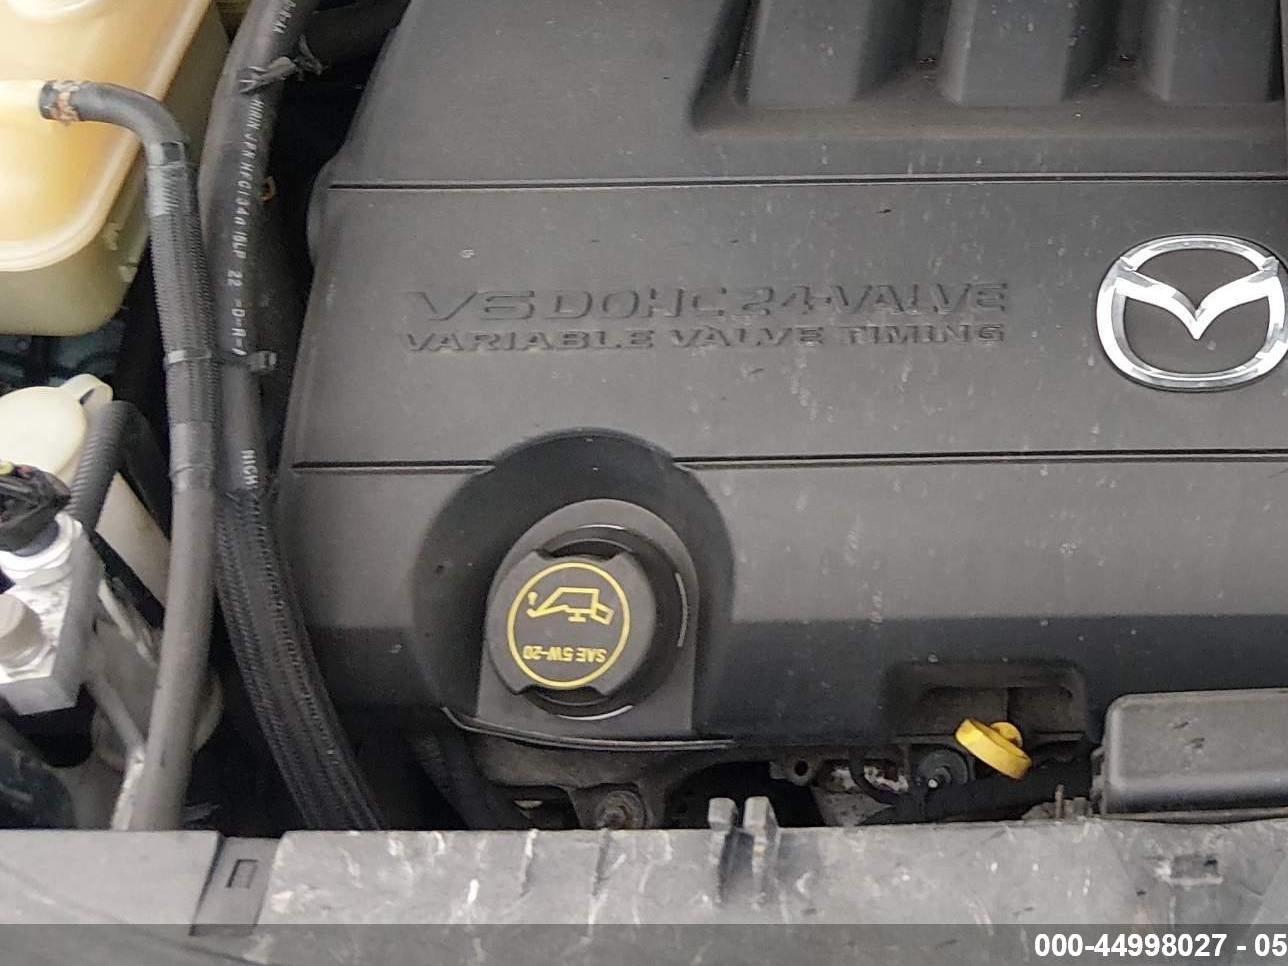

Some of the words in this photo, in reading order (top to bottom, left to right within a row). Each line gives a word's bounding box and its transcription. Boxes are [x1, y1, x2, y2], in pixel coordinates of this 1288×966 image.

[545, 287, 726, 320] DOHC
[405, 329, 655, 353] VARIABLE
[670, 325, 825, 348] VALVE
[842, 322, 1006, 346] TIMING
[522, 644, 574, 662] 5W-20
[575, 646, 607, 663] SAE
